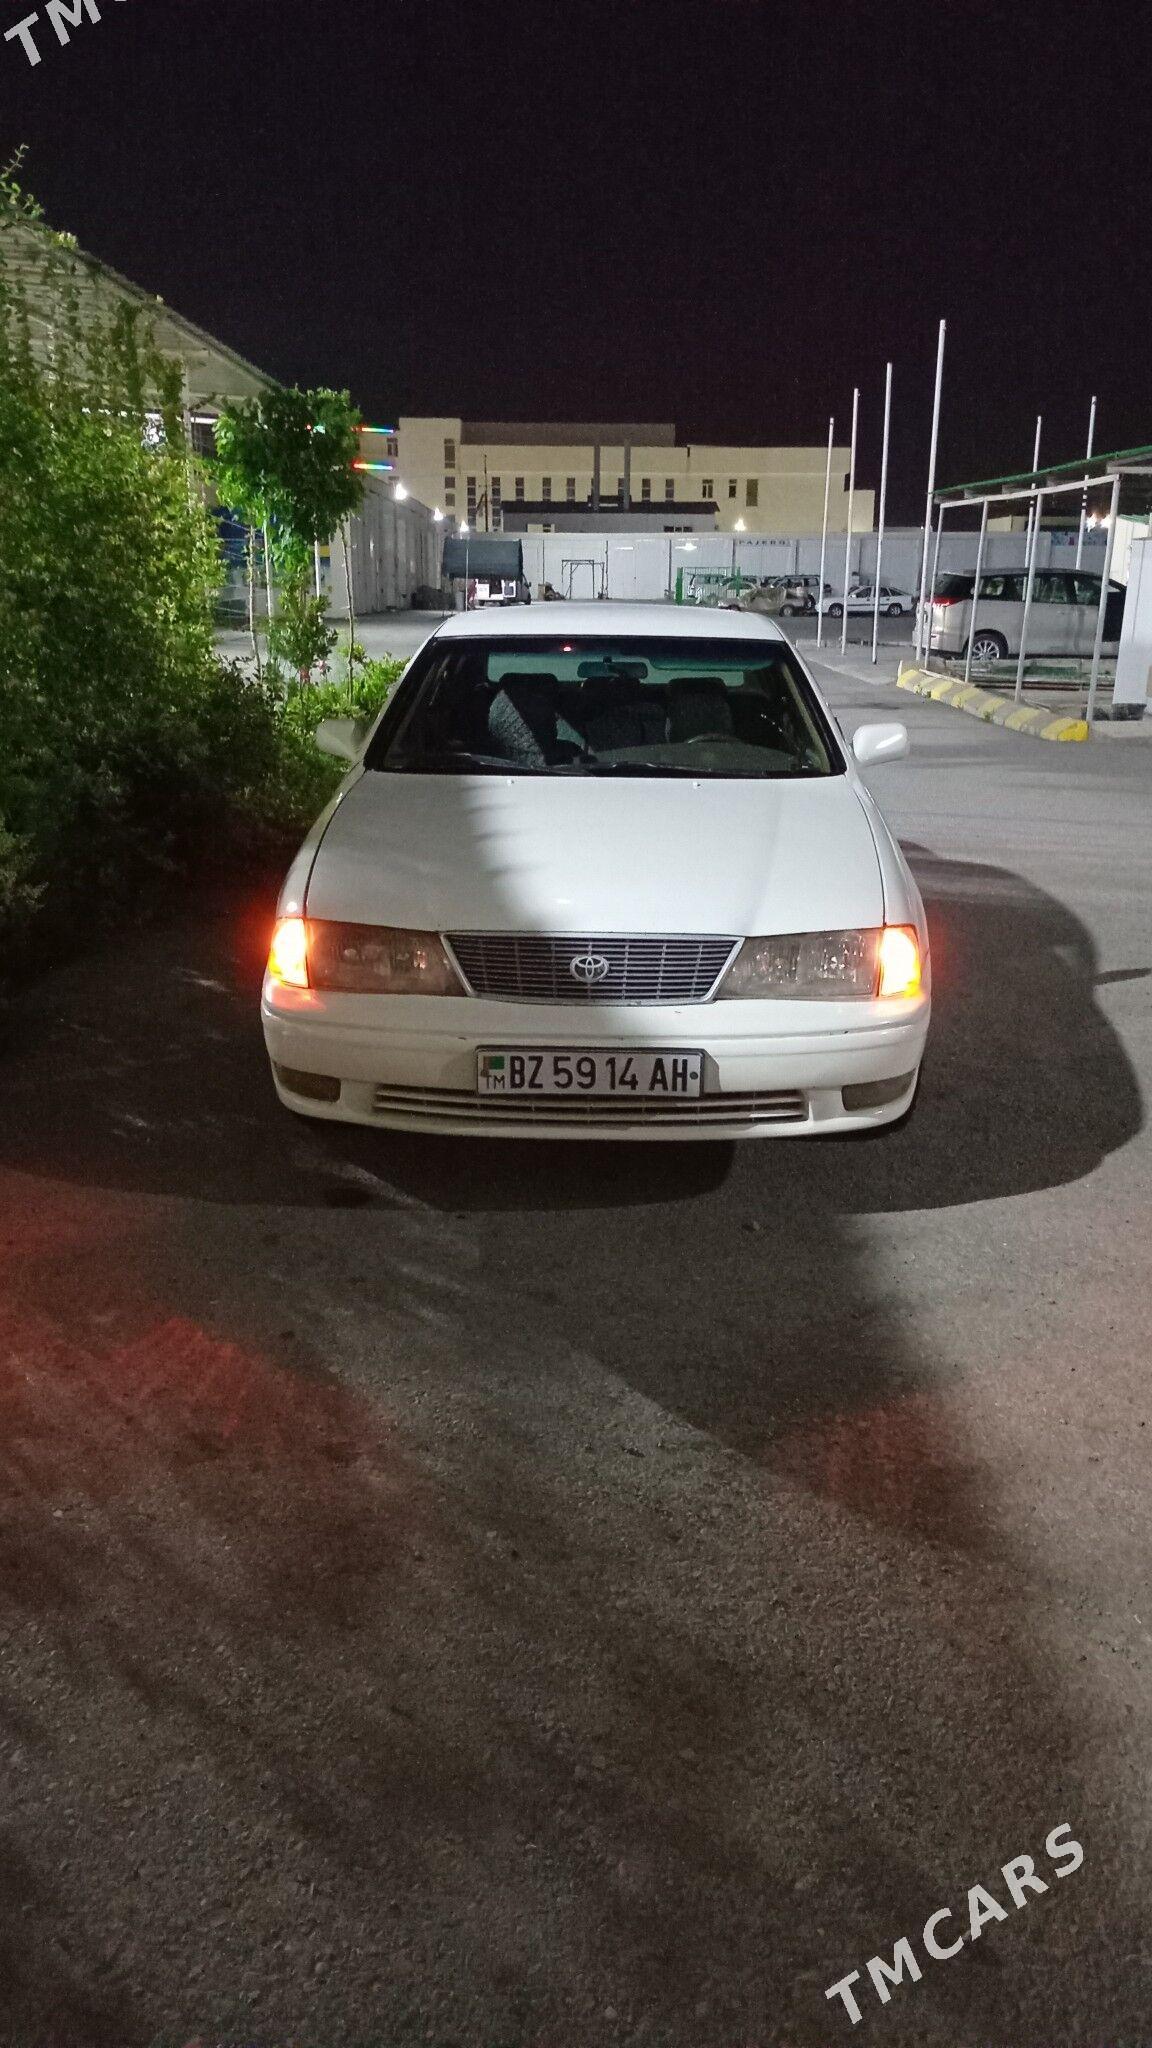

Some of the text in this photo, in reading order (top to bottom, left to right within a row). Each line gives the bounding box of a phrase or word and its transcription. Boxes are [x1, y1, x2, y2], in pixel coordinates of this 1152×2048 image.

[486, 1075, 505, 1090] TM
[510, 1056, 688, 1092] BZ 59 14 AH
